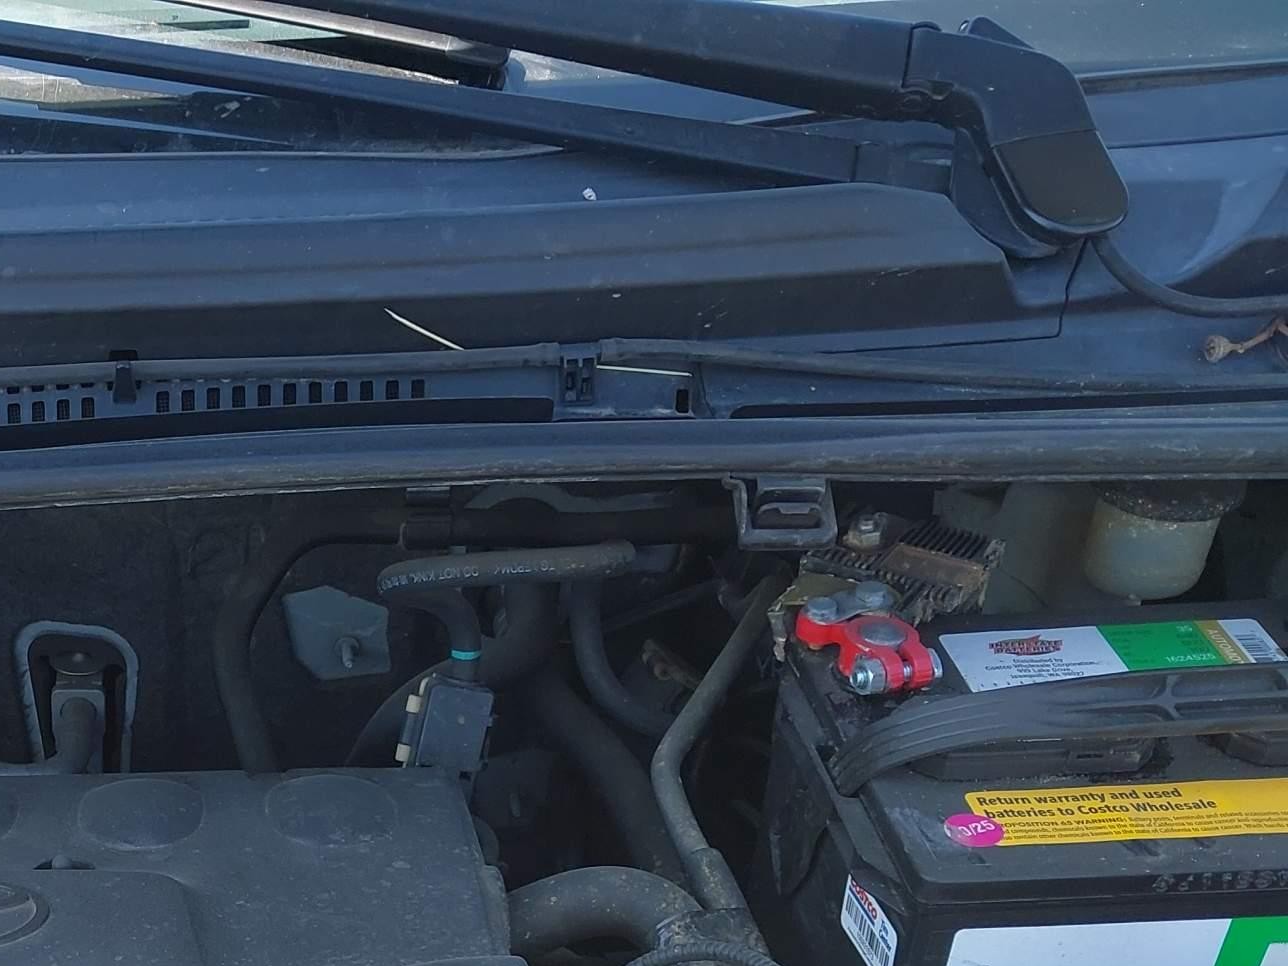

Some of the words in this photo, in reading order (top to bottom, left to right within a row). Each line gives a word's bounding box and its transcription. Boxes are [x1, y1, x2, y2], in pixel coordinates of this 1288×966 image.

[976, 795, 1034, 807] Return
[1034, 792, 1106, 806] warranty
[1111, 789, 1140, 800] and
[1143, 787, 1183, 799] used
[984, 806, 1057, 819] batteries
[1058, 806, 1074, 816] to
[1077, 803, 1130, 815] Costco
[1131, 799, 1218, 813] Wholesale
